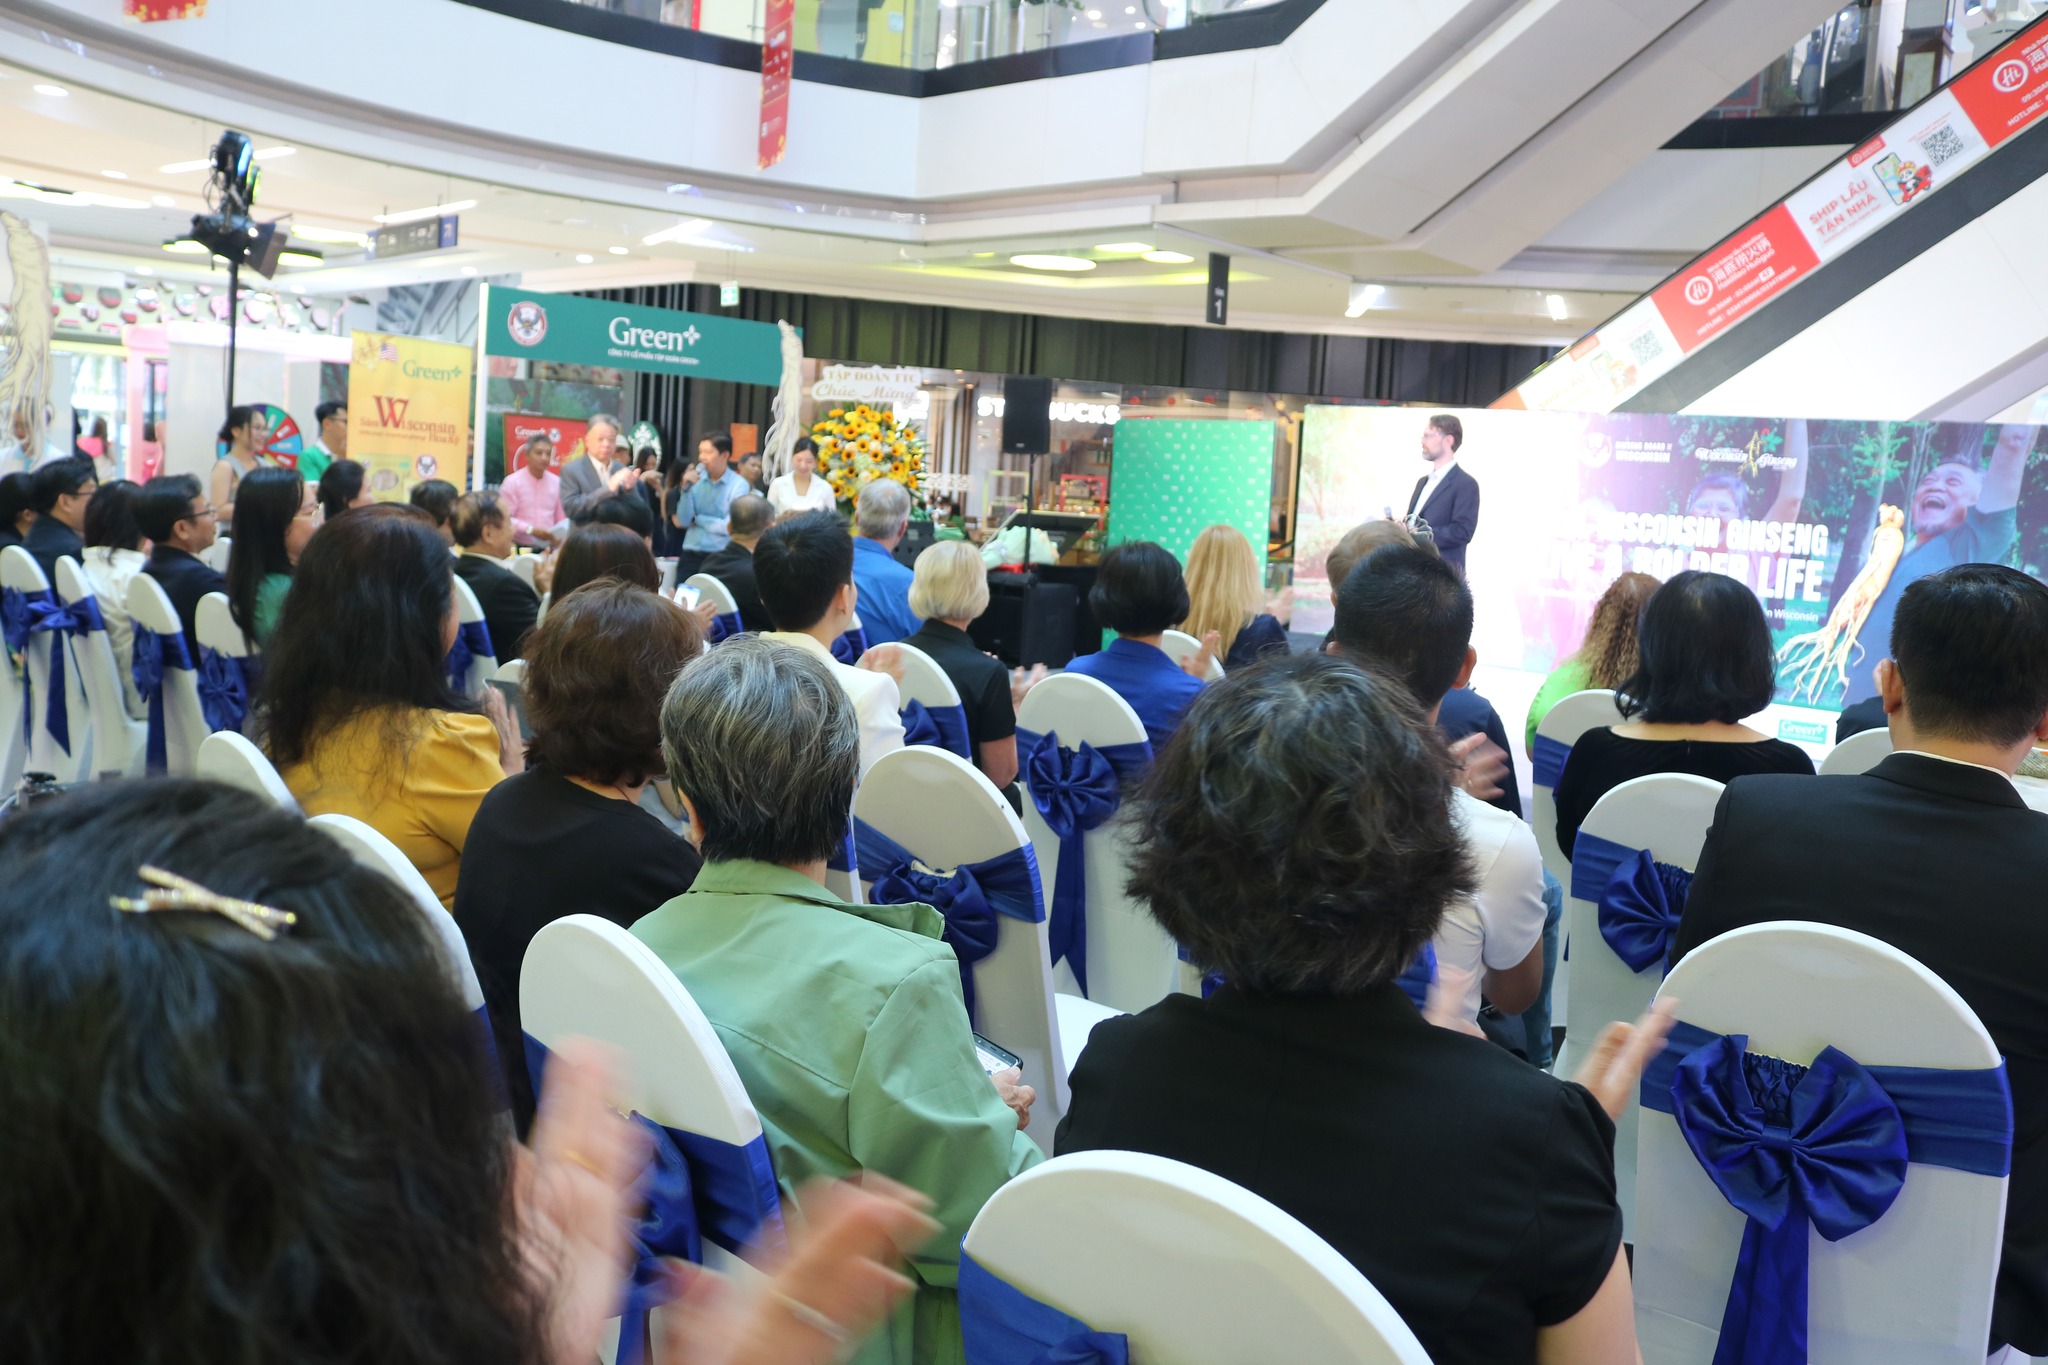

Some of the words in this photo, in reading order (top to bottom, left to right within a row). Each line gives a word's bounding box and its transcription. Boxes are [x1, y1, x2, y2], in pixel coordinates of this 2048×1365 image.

[2002, 66, 2022, 87] Hi
[1808, 198, 1839, 225] SHIP
[1215, 299, 1222, 319] 1
[374, 395, 456, 434] Wisconsin
[977, 396, 1121, 425] STUCKS
[1726, 518, 1829, 557] GINSENG
[1756, 555, 1825, 603] LIFE
[1774, 608, 1819, 623] Wisconsin
